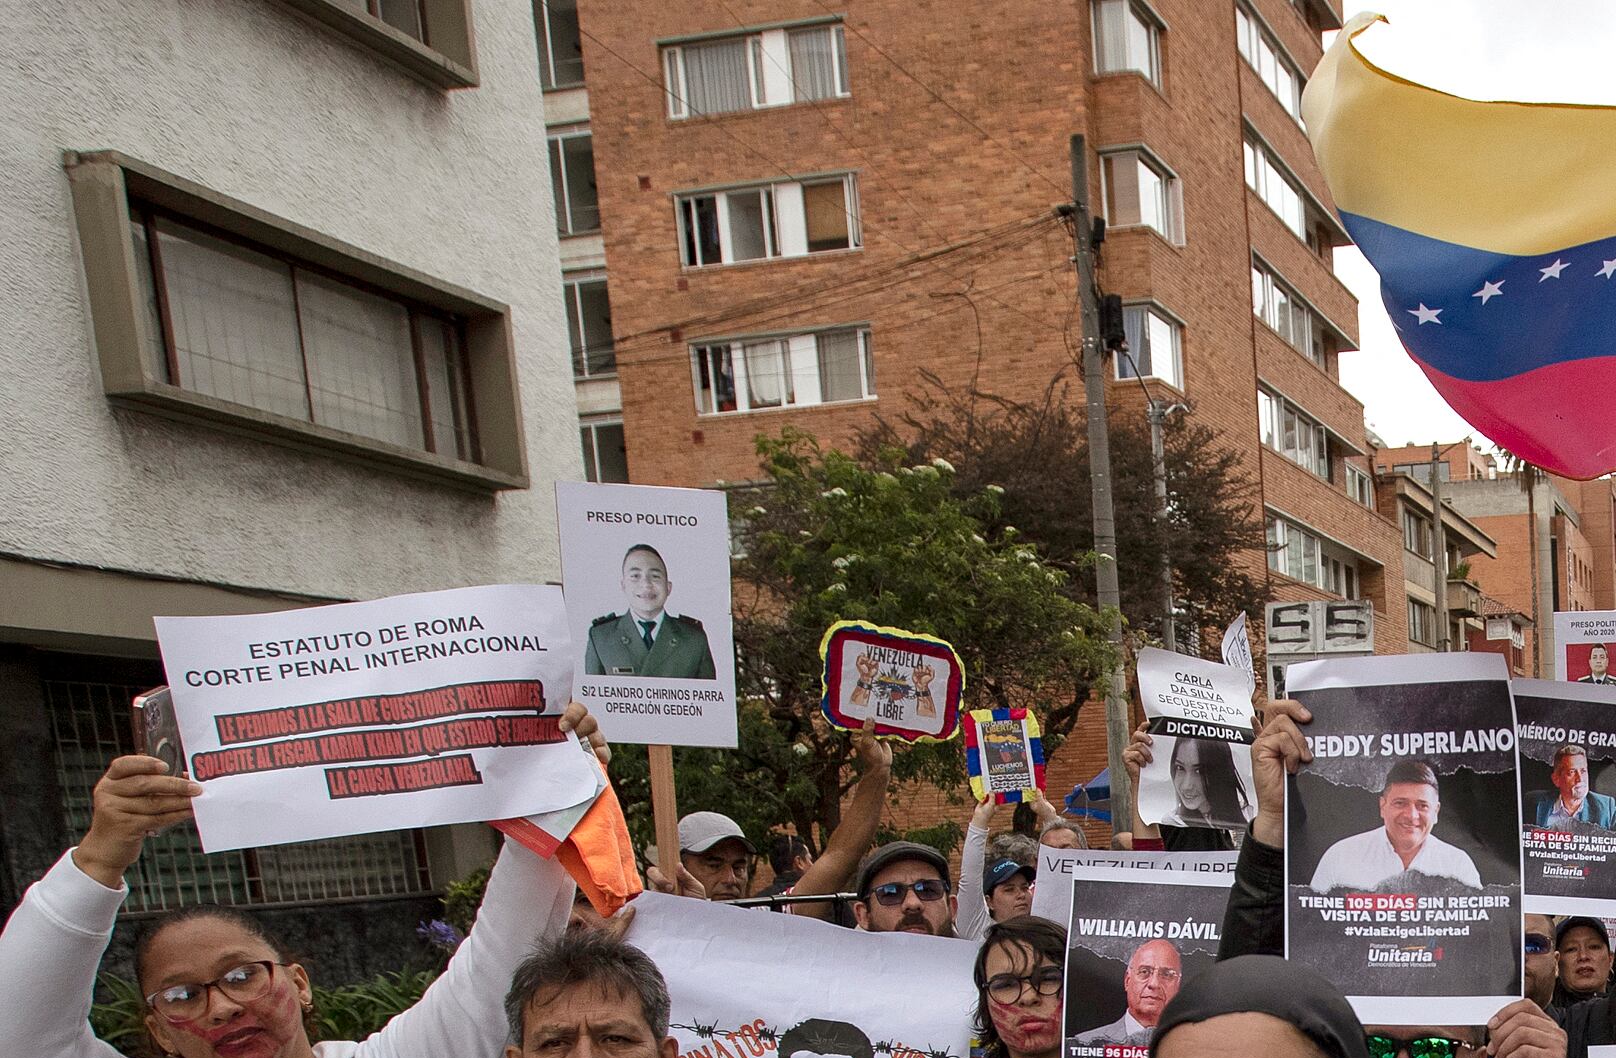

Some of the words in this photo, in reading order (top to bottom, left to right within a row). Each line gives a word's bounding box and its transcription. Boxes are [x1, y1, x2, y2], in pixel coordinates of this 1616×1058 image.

[587, 511, 633, 525] PRESO
[637, 513, 698, 527] POLITICO
[1571, 620, 1594, 628] PRESO
[249, 630, 372, 660] ESTATUTO
[379, 624, 407, 645] DE
[414, 614, 485, 637] ROMA
[185, 664, 272, 688] CORTE
[279, 653, 359, 678] PENAL
[365, 634, 548, 668] INTERNACIONAL
[866, 645, 923, 669] VENEZUELA
[1174, 671, 1214, 689] CARLA
[582, 685, 596, 698] S/2
[598, 686, 644, 699] LEANDRO
[646, 688, 690, 701] CHIRINOS
[692, 689, 724, 702] PARRA
[1170, 683, 1188, 695] DA
[1190, 688, 1225, 704] SILVA
[236, 709, 298, 739] PEDIMOS
[327, 700, 362, 725] SALA
[381, 688, 458, 721] CUESTIONES
[606, 700, 661, 715] OPERACIÓN
[663, 703, 703, 716] GEDEÓN
[876, 702, 904, 721] LIBRE
[1158, 693, 1244, 717] SECUESTRADA
[1183, 708, 1208, 720] POR
[1210, 712, 1227, 723] LA
[1166, 721, 1244, 741] DICTADURA
[1517, 721, 1566, 742] MÉRICO
[1568, 729, 1586, 744] DE
[194, 750, 255, 780] SOLICITE
[273, 739, 320, 766] FISCAL
[320, 734, 366, 761] KARIM
[366, 729, 404, 757] KHAN
[449, 719, 497, 748] ESTADO
[1305, 735, 1374, 757] REDDY
[1380, 728, 1514, 756] SUPERLANO
[348, 764, 395, 793] CAUSA
[1543, 866, 1583, 876] Unitaria
[1299, 896, 1345, 909] TIENE
[1348, 898, 1373, 909] 105
[1377, 895, 1415, 909] DÍAS
[1418, 897, 1446, 909] SIN
[1449, 896, 1510, 909] RECIBIR
[1320, 910, 1372, 922] VISITA
[1376, 911, 1397, 922] DE
[1400, 911, 1421, 922] SU
[1425, 909, 1489, 922] FAMILIA
[1079, 918, 1164, 938] WILLIAMS
[1168, 917, 1222, 940] DÁVIL
[1344, 926, 1470, 939] #VzlaExigeLibertad
[1368, 949, 1433, 962] Unitaria
[1070, 1047, 1103, 1057] TIENE
[1106, 1048, 1120, 1058] 96
[1123, 1046, 1149, 1058] DÍAS
